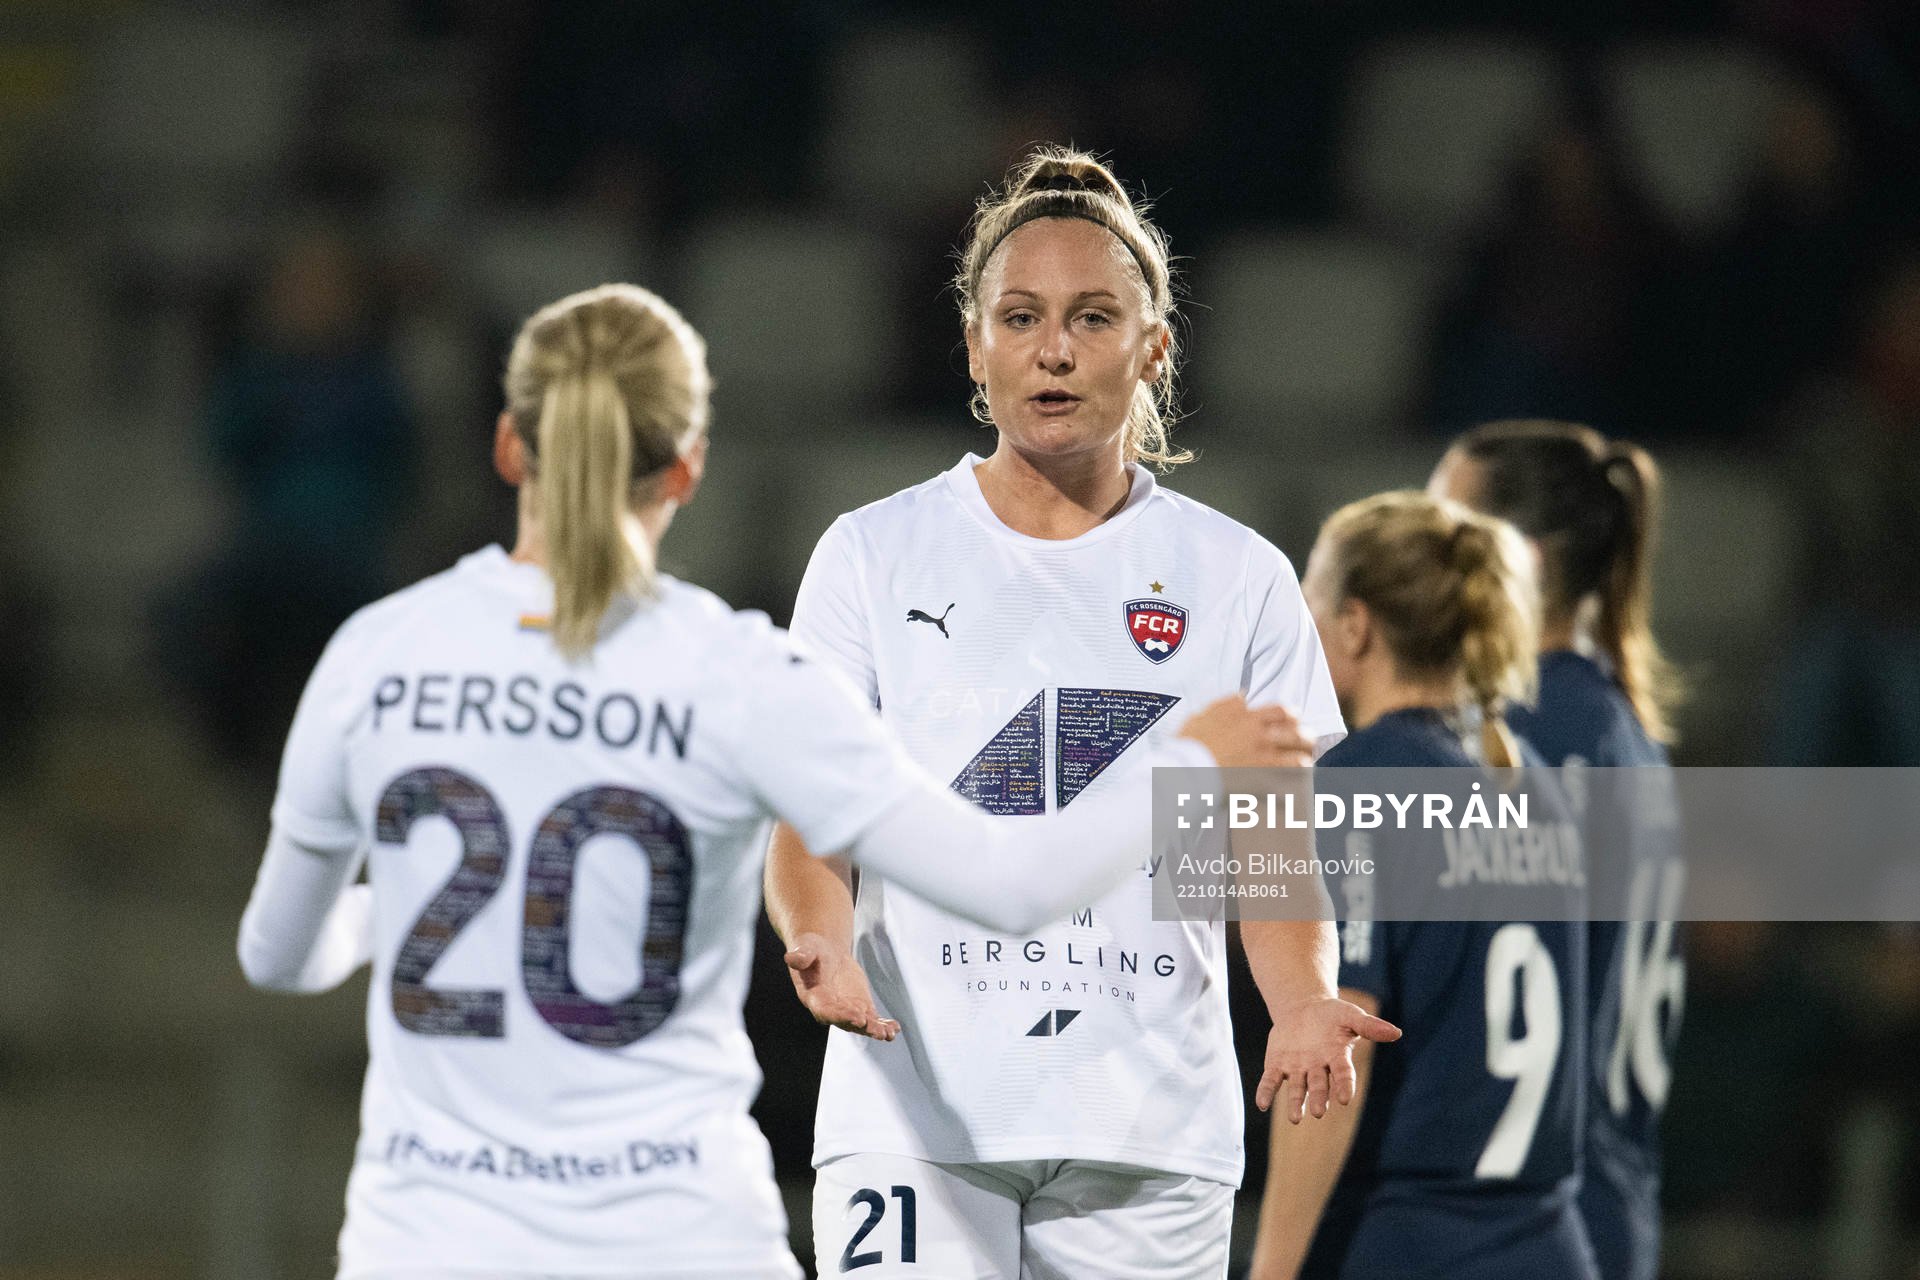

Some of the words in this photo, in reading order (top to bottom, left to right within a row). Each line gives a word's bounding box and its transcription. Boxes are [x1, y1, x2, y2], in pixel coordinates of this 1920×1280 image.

[1133, 614, 1179, 634] FCR
[1140, 603, 1182, 617] ROSENGÅRD
[372, 674, 694, 760] PERSSON
[375, 765, 693, 1047] 20
[942, 940, 1175, 976] BERGLING
[1475, 923, 1562, 1178] 9
[839, 1185, 916, 1273] 21
